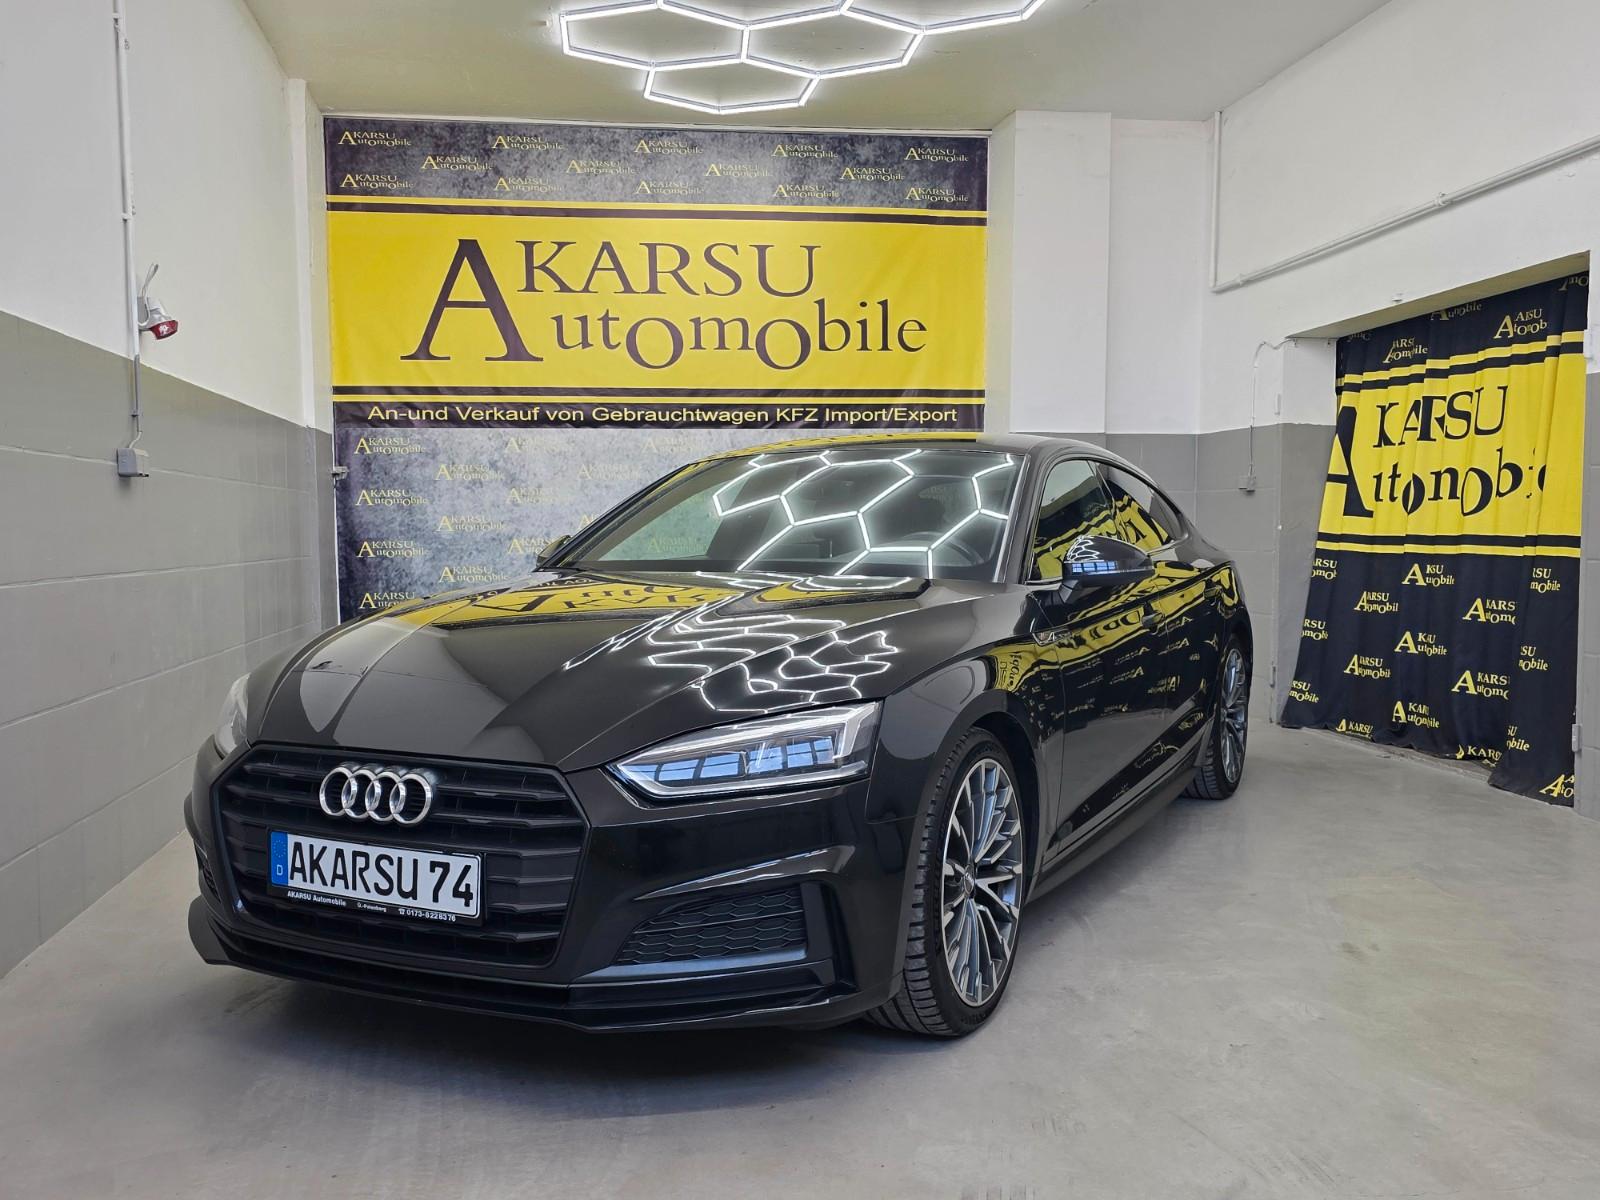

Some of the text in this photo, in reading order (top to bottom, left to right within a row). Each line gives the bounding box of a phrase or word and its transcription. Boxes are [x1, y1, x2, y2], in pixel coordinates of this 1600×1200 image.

[367, 406, 957, 424] An-und Verkauf von Gebrauchtwagen KFZ Import/Export
[276, 864, 283, 876] D
[290, 842, 473, 907] AKARSU 74
[287, 890, 312, 900] AKARSU
